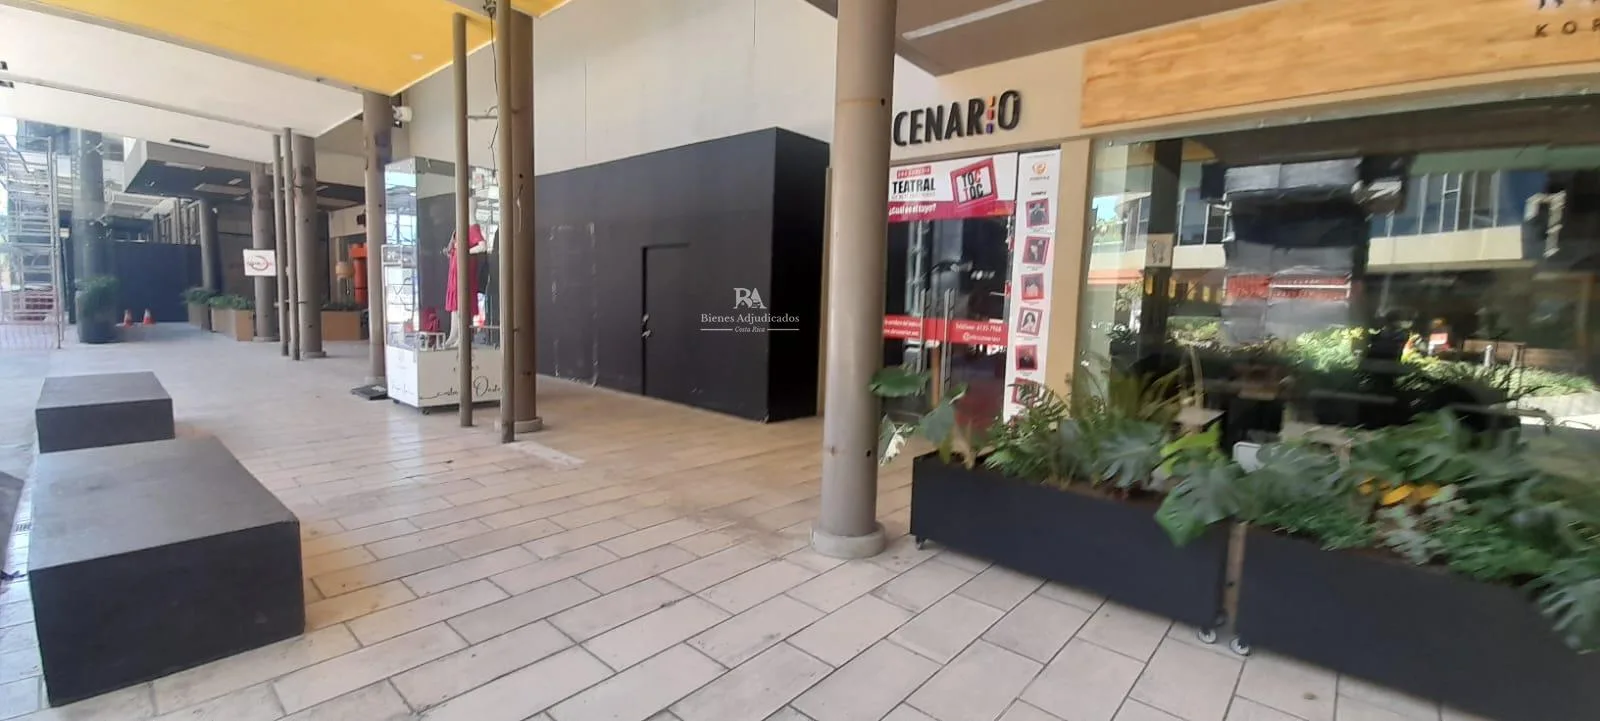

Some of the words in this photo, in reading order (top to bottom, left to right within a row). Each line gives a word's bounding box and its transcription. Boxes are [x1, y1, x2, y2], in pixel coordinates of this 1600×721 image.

[892, 177, 936, 194] TEATRAL
[961, 170, 982, 188] TOC
[963, 184, 984, 201] TOC
